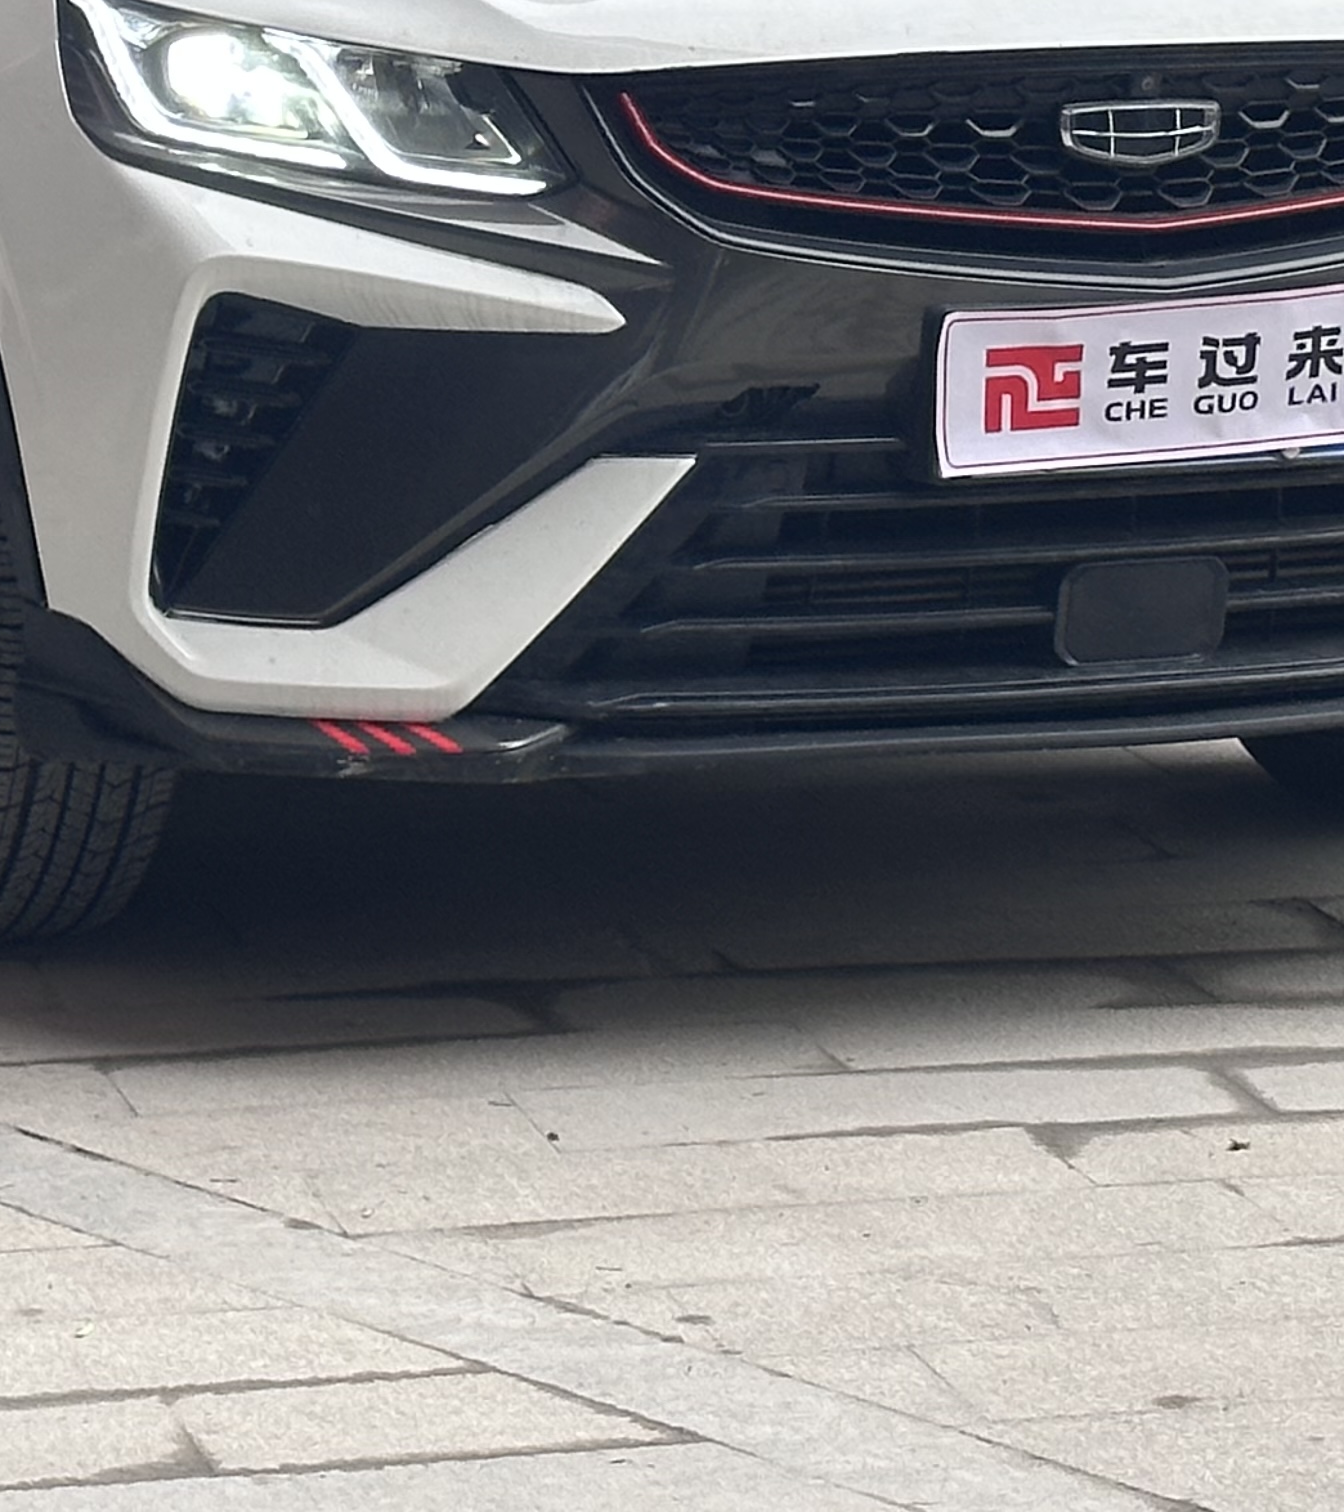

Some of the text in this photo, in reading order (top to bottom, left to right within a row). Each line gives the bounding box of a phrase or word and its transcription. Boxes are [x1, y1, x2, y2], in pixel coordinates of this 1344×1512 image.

[1106, 325, 1344, 394] 车过来
[1104, 381, 1338, 424] CHE GUO LAI
